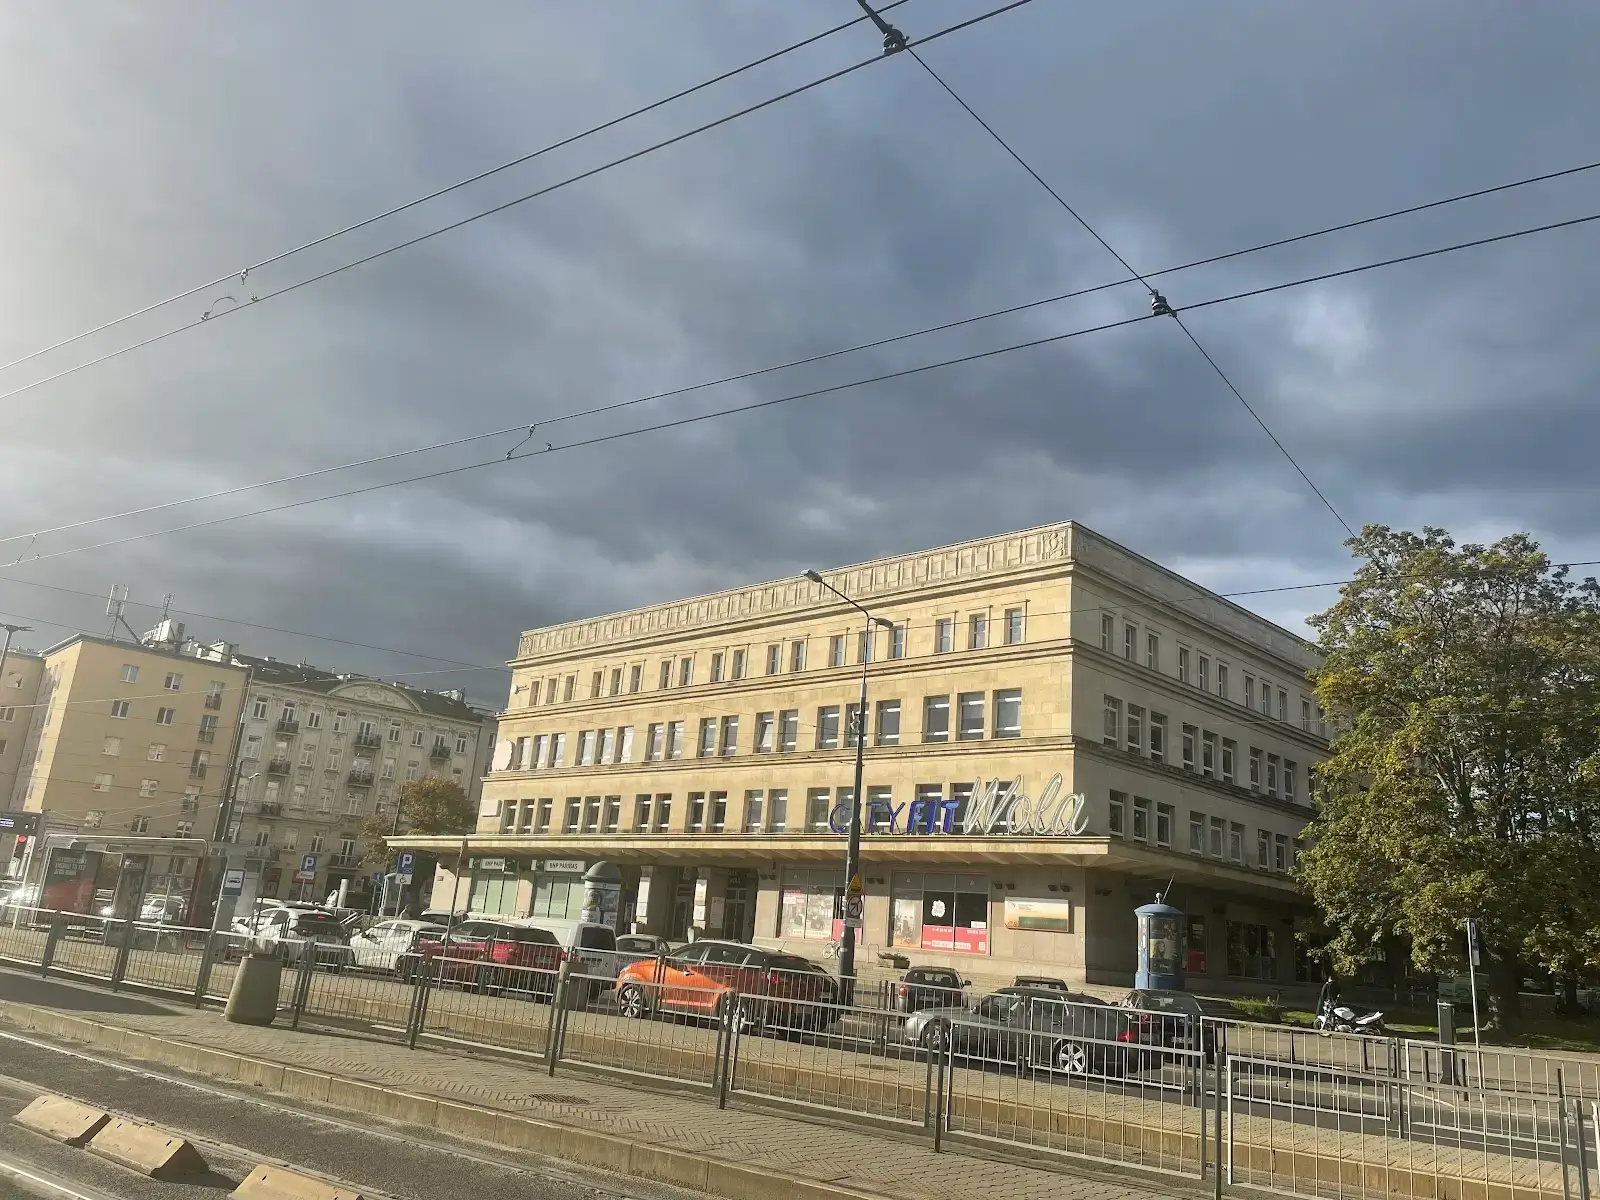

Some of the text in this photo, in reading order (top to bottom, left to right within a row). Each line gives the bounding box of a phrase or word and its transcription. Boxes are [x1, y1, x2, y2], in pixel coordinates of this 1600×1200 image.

[829, 772, 1089, 836] CTYFIT Wola
[304, 856, 315, 870] P
[401, 854, 412, 868] P
